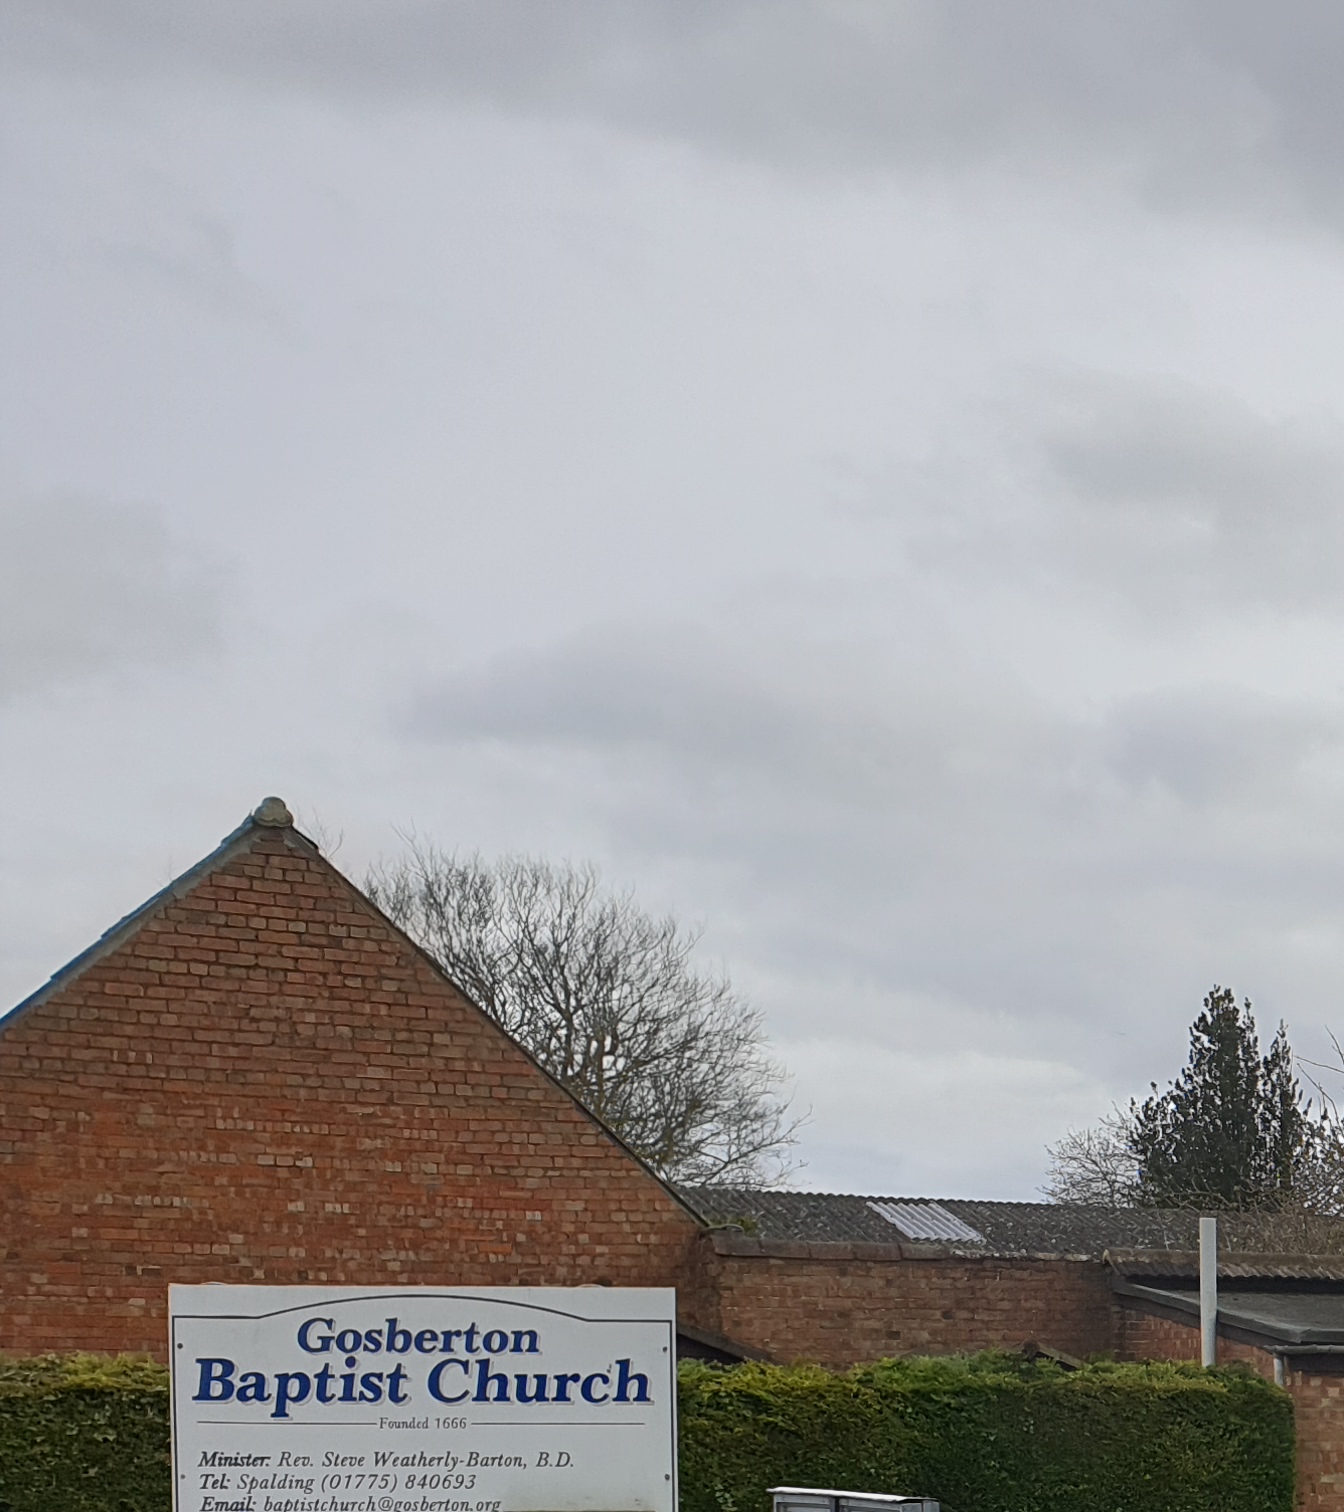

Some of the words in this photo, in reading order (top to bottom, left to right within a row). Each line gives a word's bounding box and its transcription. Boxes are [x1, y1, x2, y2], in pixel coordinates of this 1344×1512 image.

[297, 1317, 541, 1354] Gosberton
[192, 1356, 409, 1418] Baptist
[427, 1358, 652, 1404] Church
[379, 1417, 429, 1429] Founded
[435, 1417, 467, 1429] 1666
[277, 1451, 314, 1467] Rev.
[322, 1451, 365, 1467] Steve
[373, 1451, 528, 1472] Weatherly-Barton,
[535, 1451, 575, 1467] B.D.
[200, 1474, 231, 1490] Tel:
[236, 1473, 315, 1494] Spalding
[321, 1473, 398, 1493] (01775)
[404, 1474, 477, 1490] 840693
[200, 1496, 257, 1512] Email:
